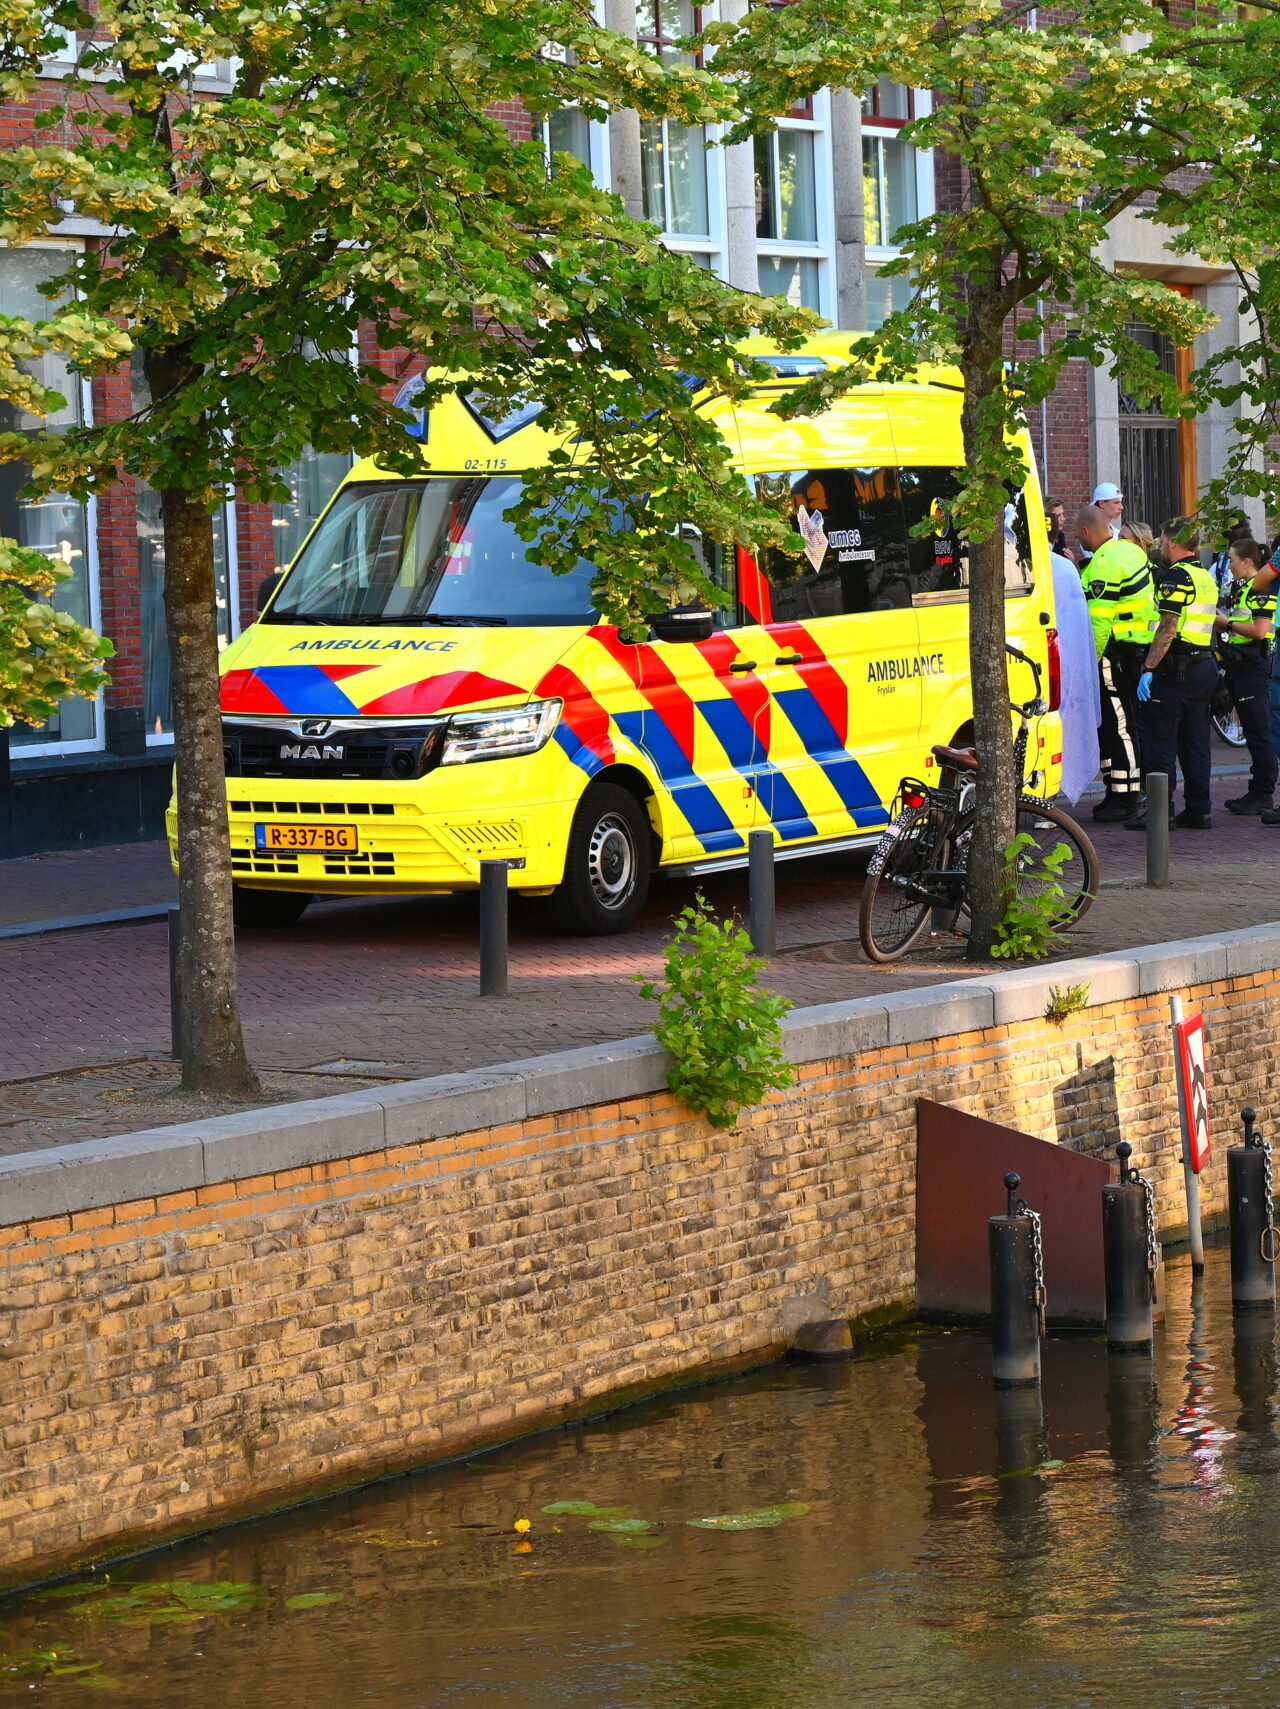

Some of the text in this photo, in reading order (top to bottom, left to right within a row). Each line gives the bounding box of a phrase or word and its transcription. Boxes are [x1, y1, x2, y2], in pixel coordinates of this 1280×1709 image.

[464, 458, 508, 470] 02-115
[288, 639, 459, 652] AMBULANCE
[867, 653, 945, 683] AMBULANCE
[280, 744, 344, 760] MAN
[271, 828, 348, 847] R-337-BG
